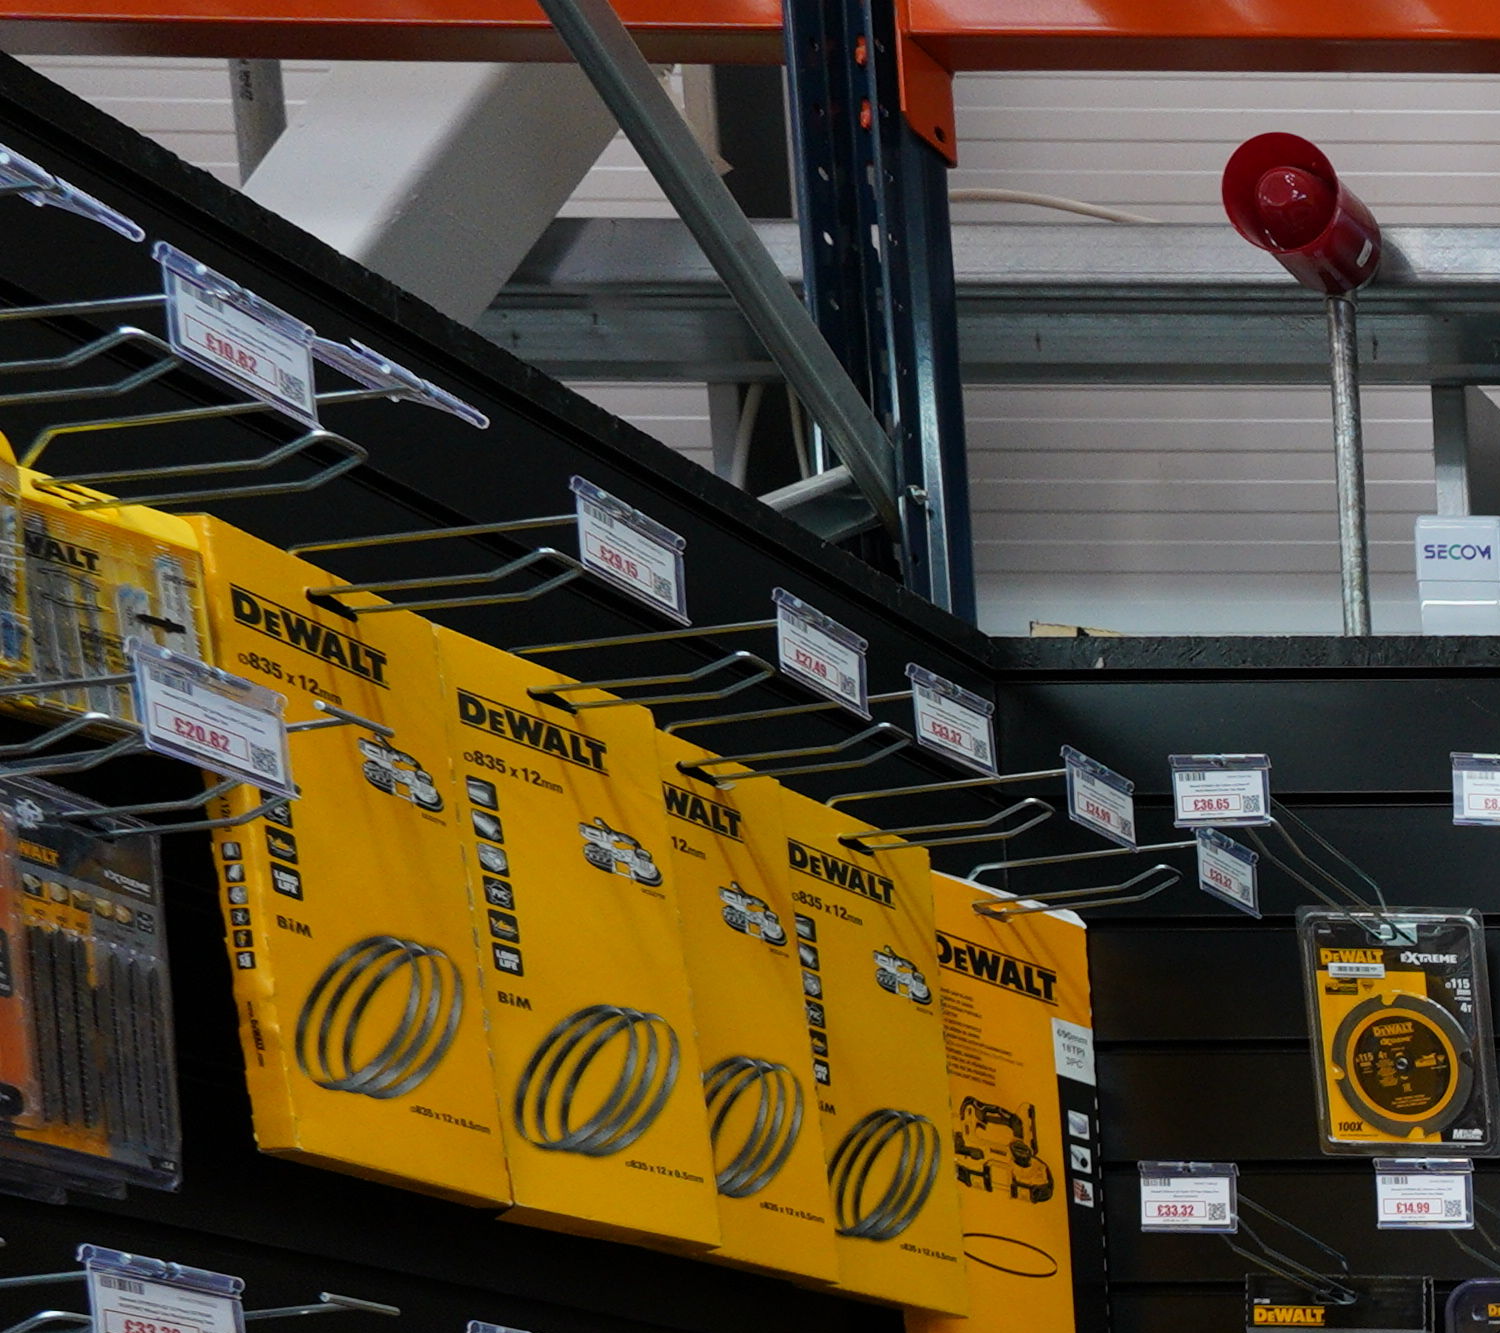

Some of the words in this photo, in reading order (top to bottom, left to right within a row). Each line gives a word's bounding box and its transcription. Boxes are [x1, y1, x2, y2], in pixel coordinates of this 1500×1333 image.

[206, 334, 257, 371] £10.82
[599, 546, 639, 577] £29.15
[1424, 544, 1491, 560] SECOM
[230, 583, 390, 690] DEWALT
[174, 718, 228, 751] £20.82
[1194, 799, 1229, 811] £36.65
[787, 837, 896, 910] DEWALT
[1320, 948, 1384, 964] DEWALT
[935, 930, 1058, 1007] DEWALT
[1156, 1205, 1194, 1217] £33.32
[1395, 1203, 1430, 1214] £14.99
[1254, 1308, 1324, 1325] DEWALT
